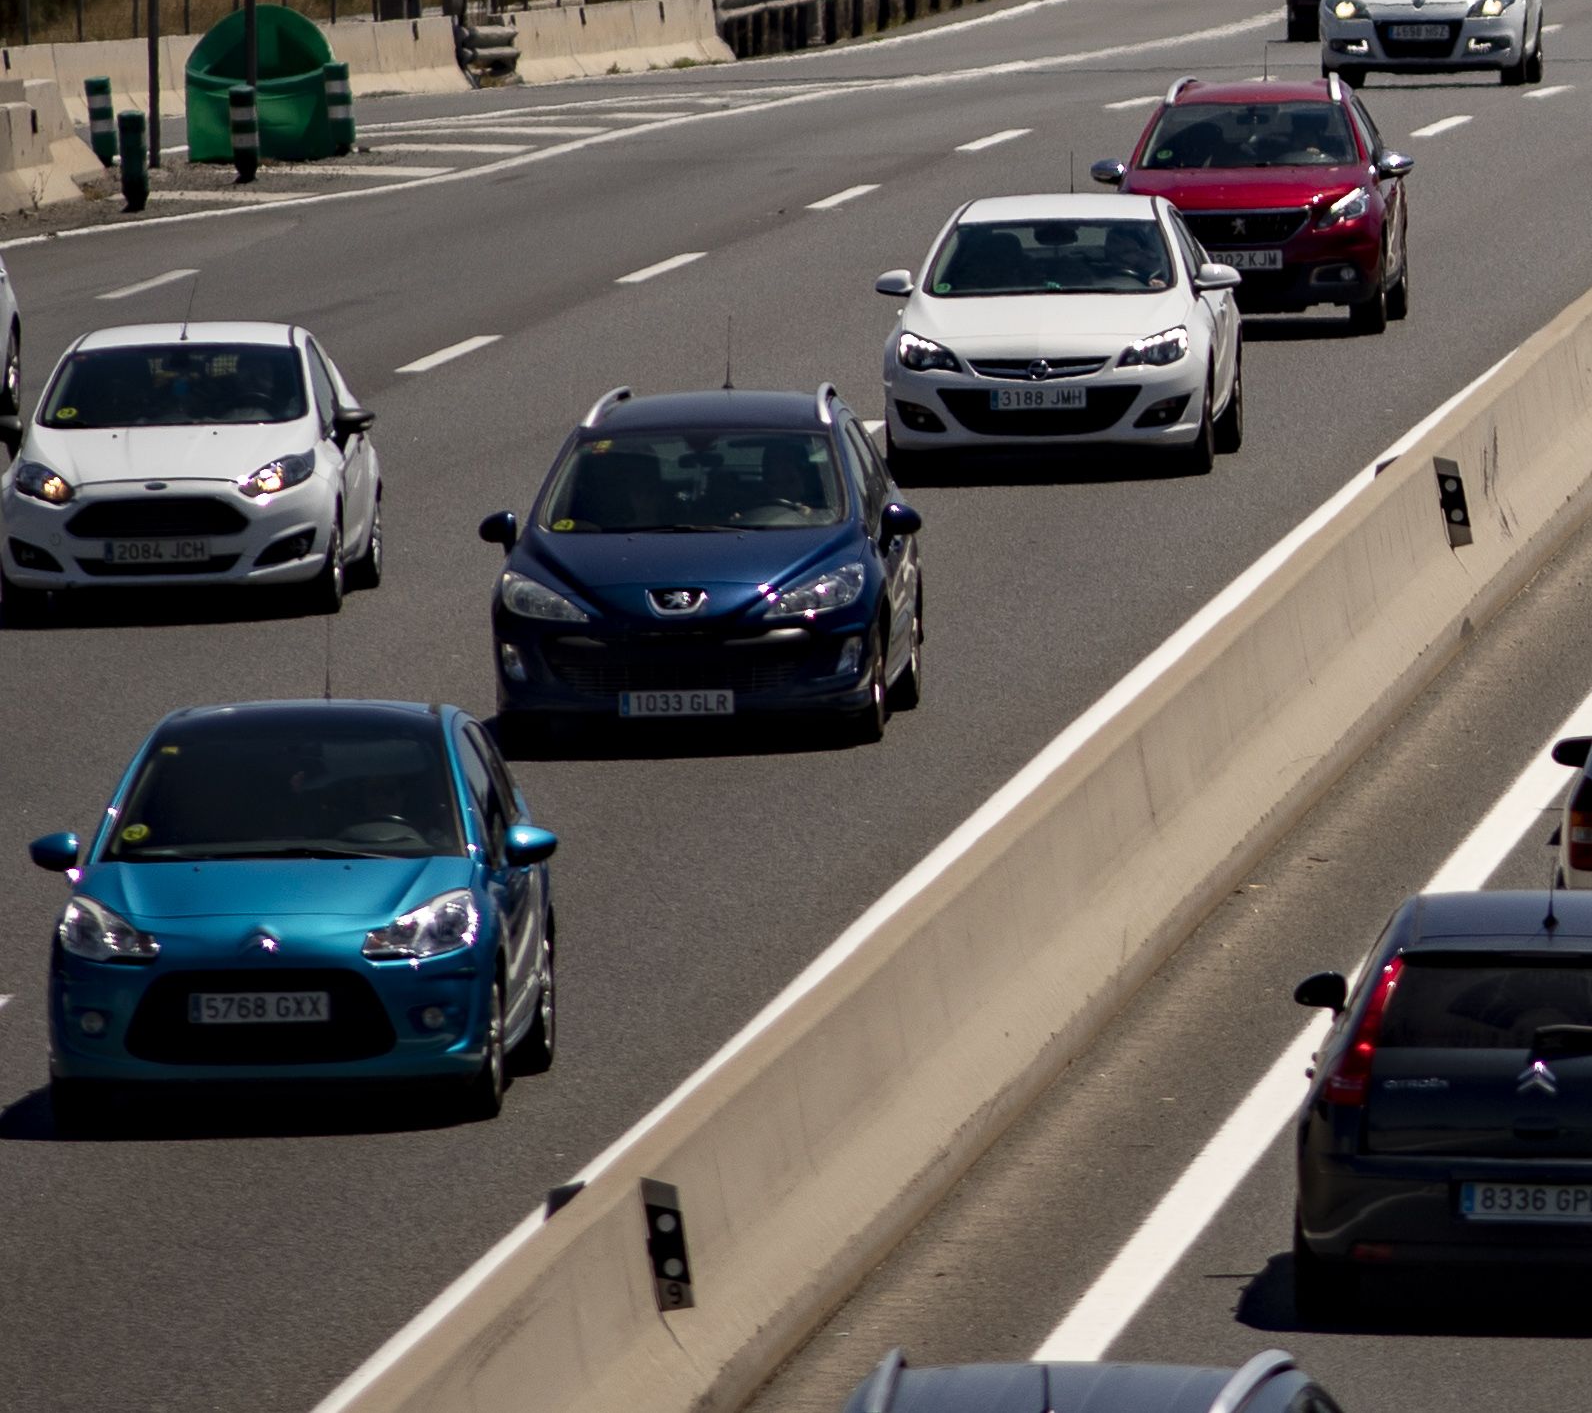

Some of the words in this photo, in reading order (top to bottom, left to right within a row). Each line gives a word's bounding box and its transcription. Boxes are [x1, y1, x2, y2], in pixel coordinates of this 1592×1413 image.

[1248, 250, 1278, 267] KJM
[1002, 390, 1044, 407] 3188
[1050, 389, 1083, 406] JMH
[117, 542, 163, 561] 2084
[171, 541, 205, 559] JCH
[636, 693, 683, 713] 1033
[690, 693, 728, 712] GLR
[205, 996, 267, 1019] 5768
[276, 995, 322, 1018] GXX
[1481, 1188, 1547, 1211] 8336
